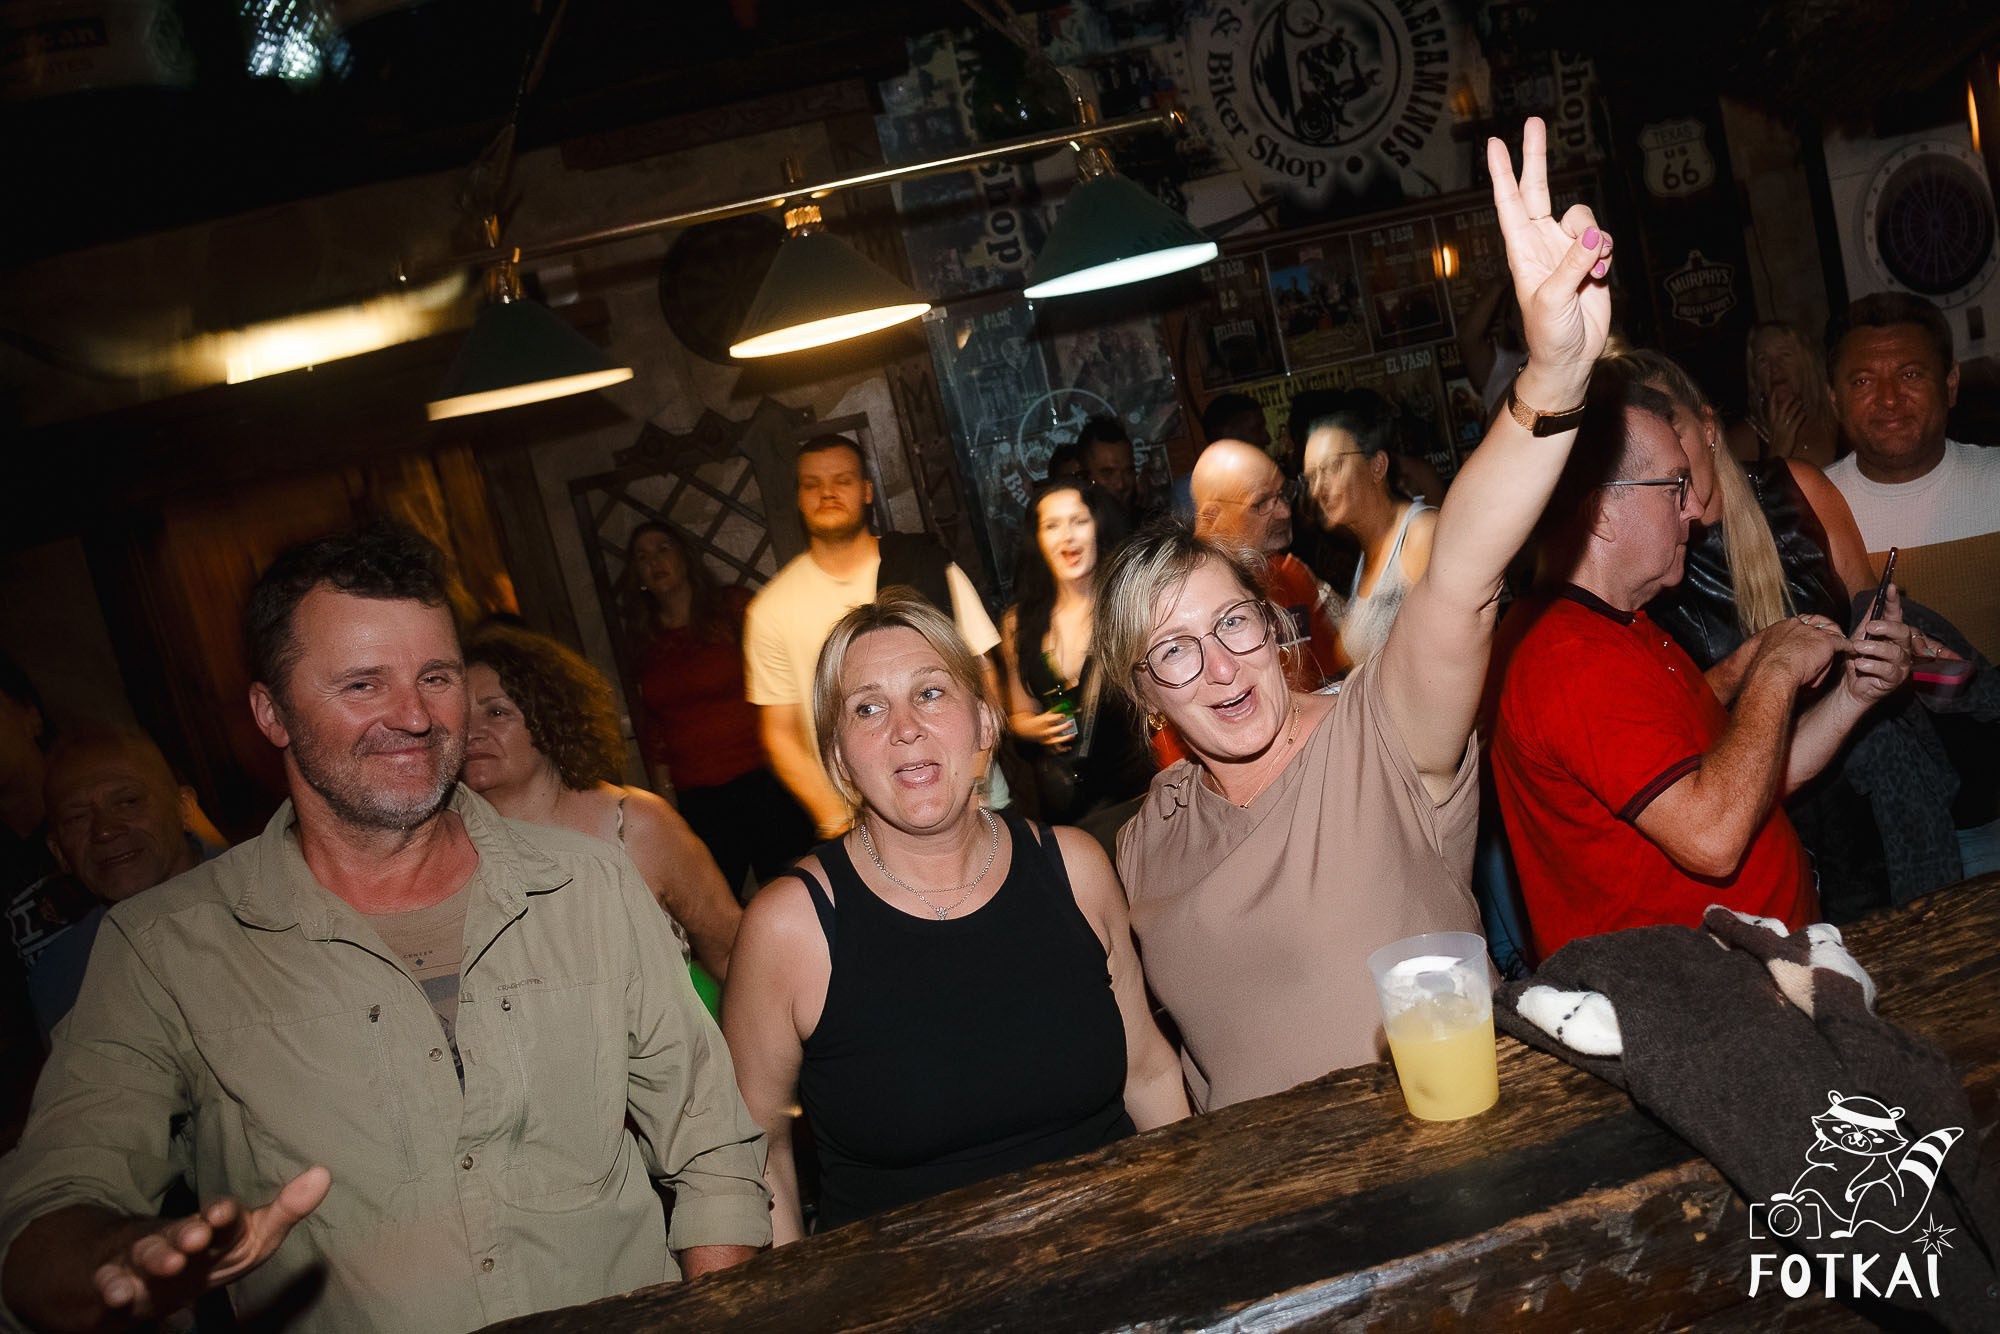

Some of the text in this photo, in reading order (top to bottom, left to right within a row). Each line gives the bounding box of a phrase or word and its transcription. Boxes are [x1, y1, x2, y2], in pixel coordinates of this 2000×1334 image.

[1207, 50, 1249, 139] Biker
[1247, 134, 1327, 188] Shop
[1653, 124, 1693, 145] TEXAS
[1663, 158, 1700, 190] 66
[1385, 358, 1402, 375] EL
[1403, 349, 1432, 371] PASO
